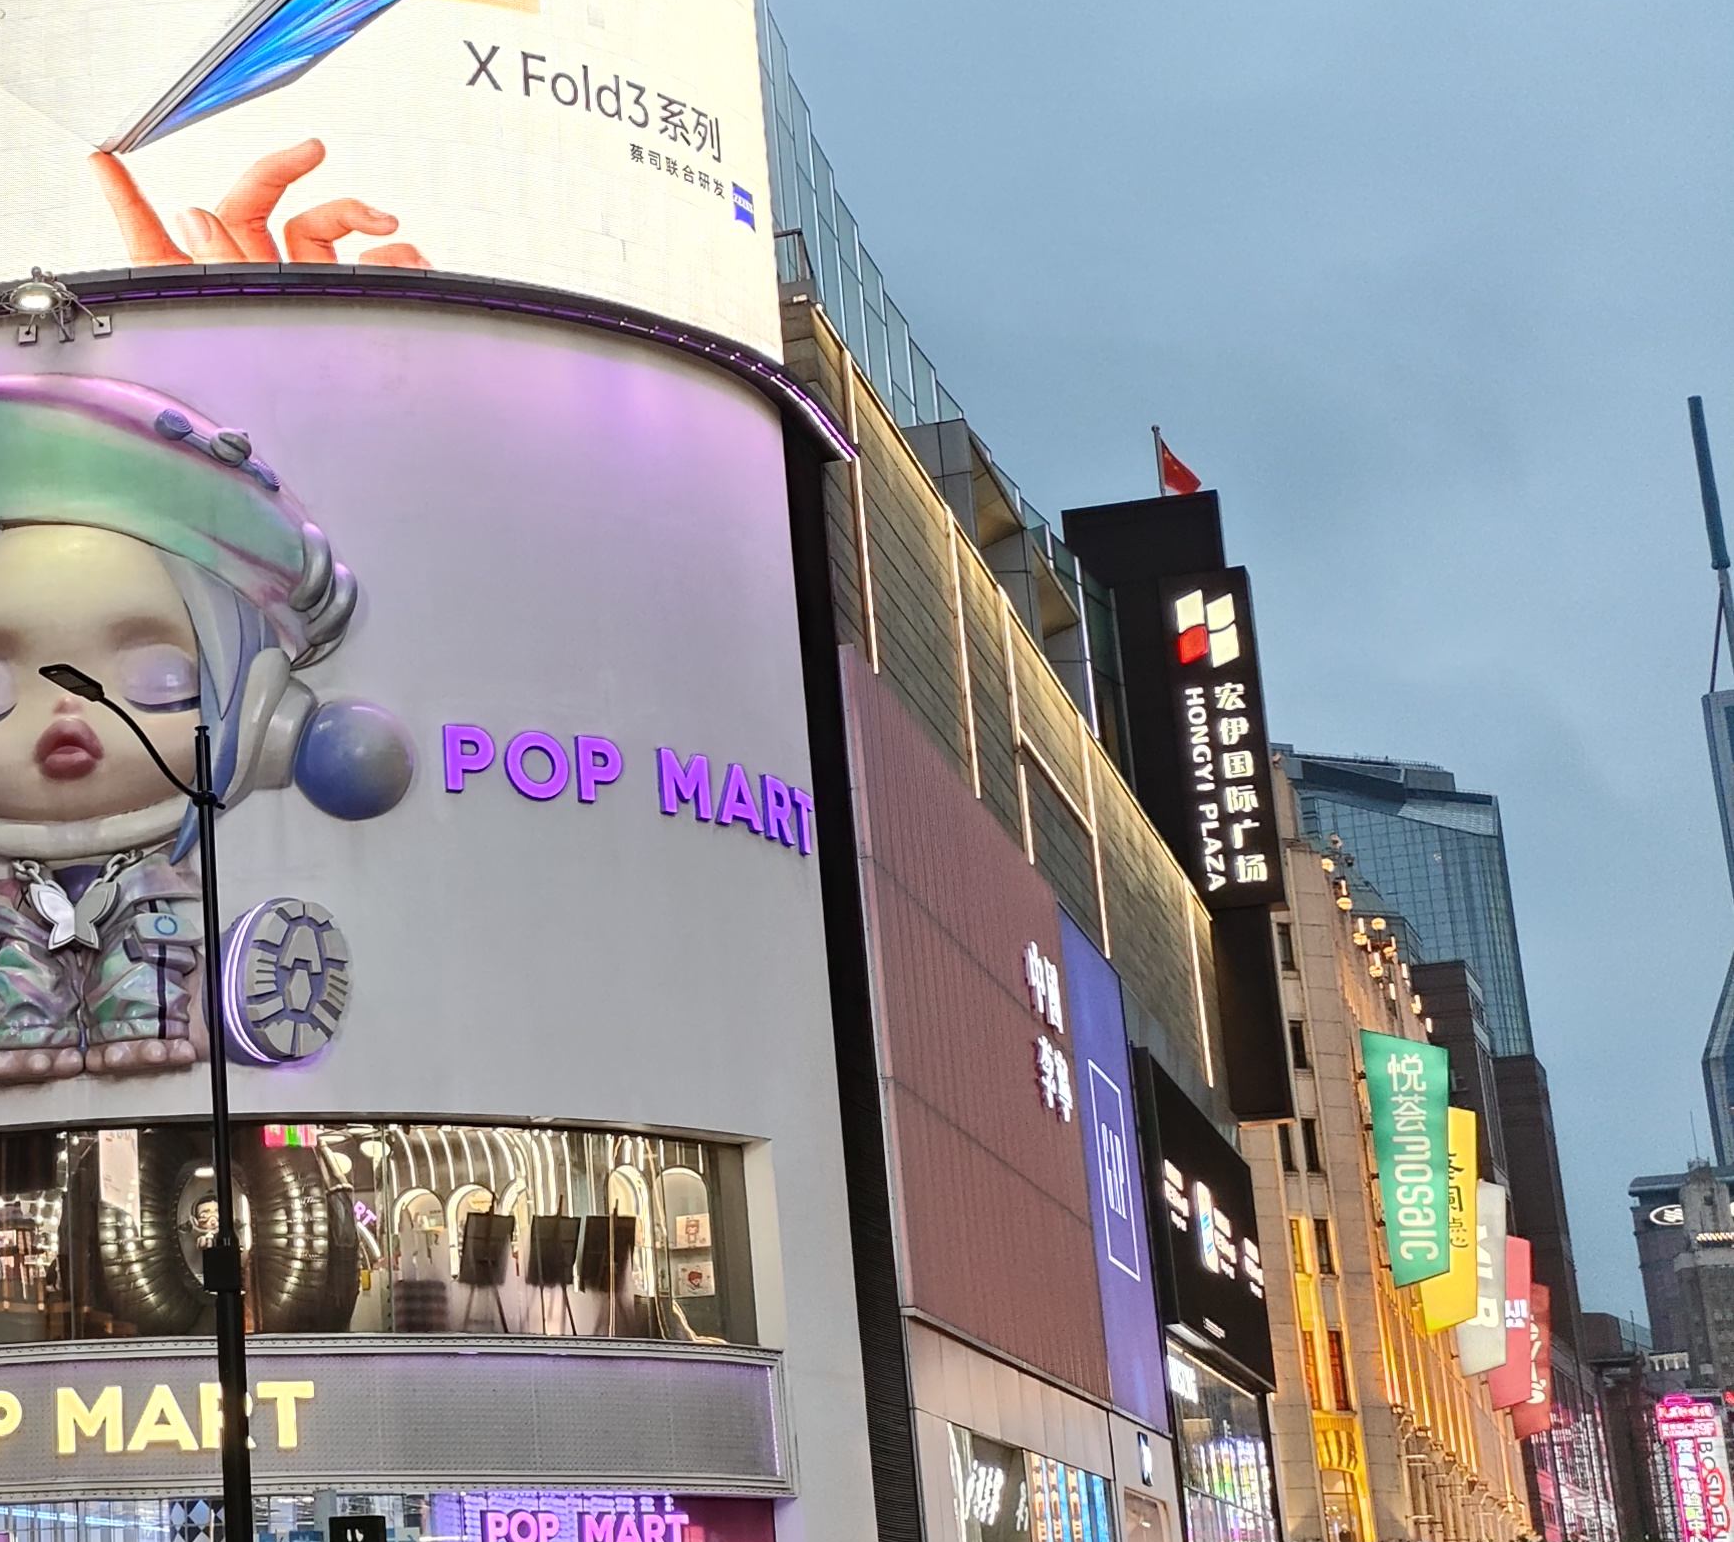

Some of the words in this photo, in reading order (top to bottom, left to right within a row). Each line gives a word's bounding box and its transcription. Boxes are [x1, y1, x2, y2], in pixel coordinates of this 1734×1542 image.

[463, 39, 503, 92] X
[521, 50, 722, 163] Fold3系列
[629, 143, 726, 200] 蔡司联合研发
[442, 723, 624, 804] POP
[656, 746, 814, 856] MART
[1184, 686, 1217, 793] HONGYI
[1214, 682, 1268, 883] 宏伊国际广场
[1198, 802, 1227, 892] PLAZA
[1387, 1052, 1428, 1133] 悦荟
